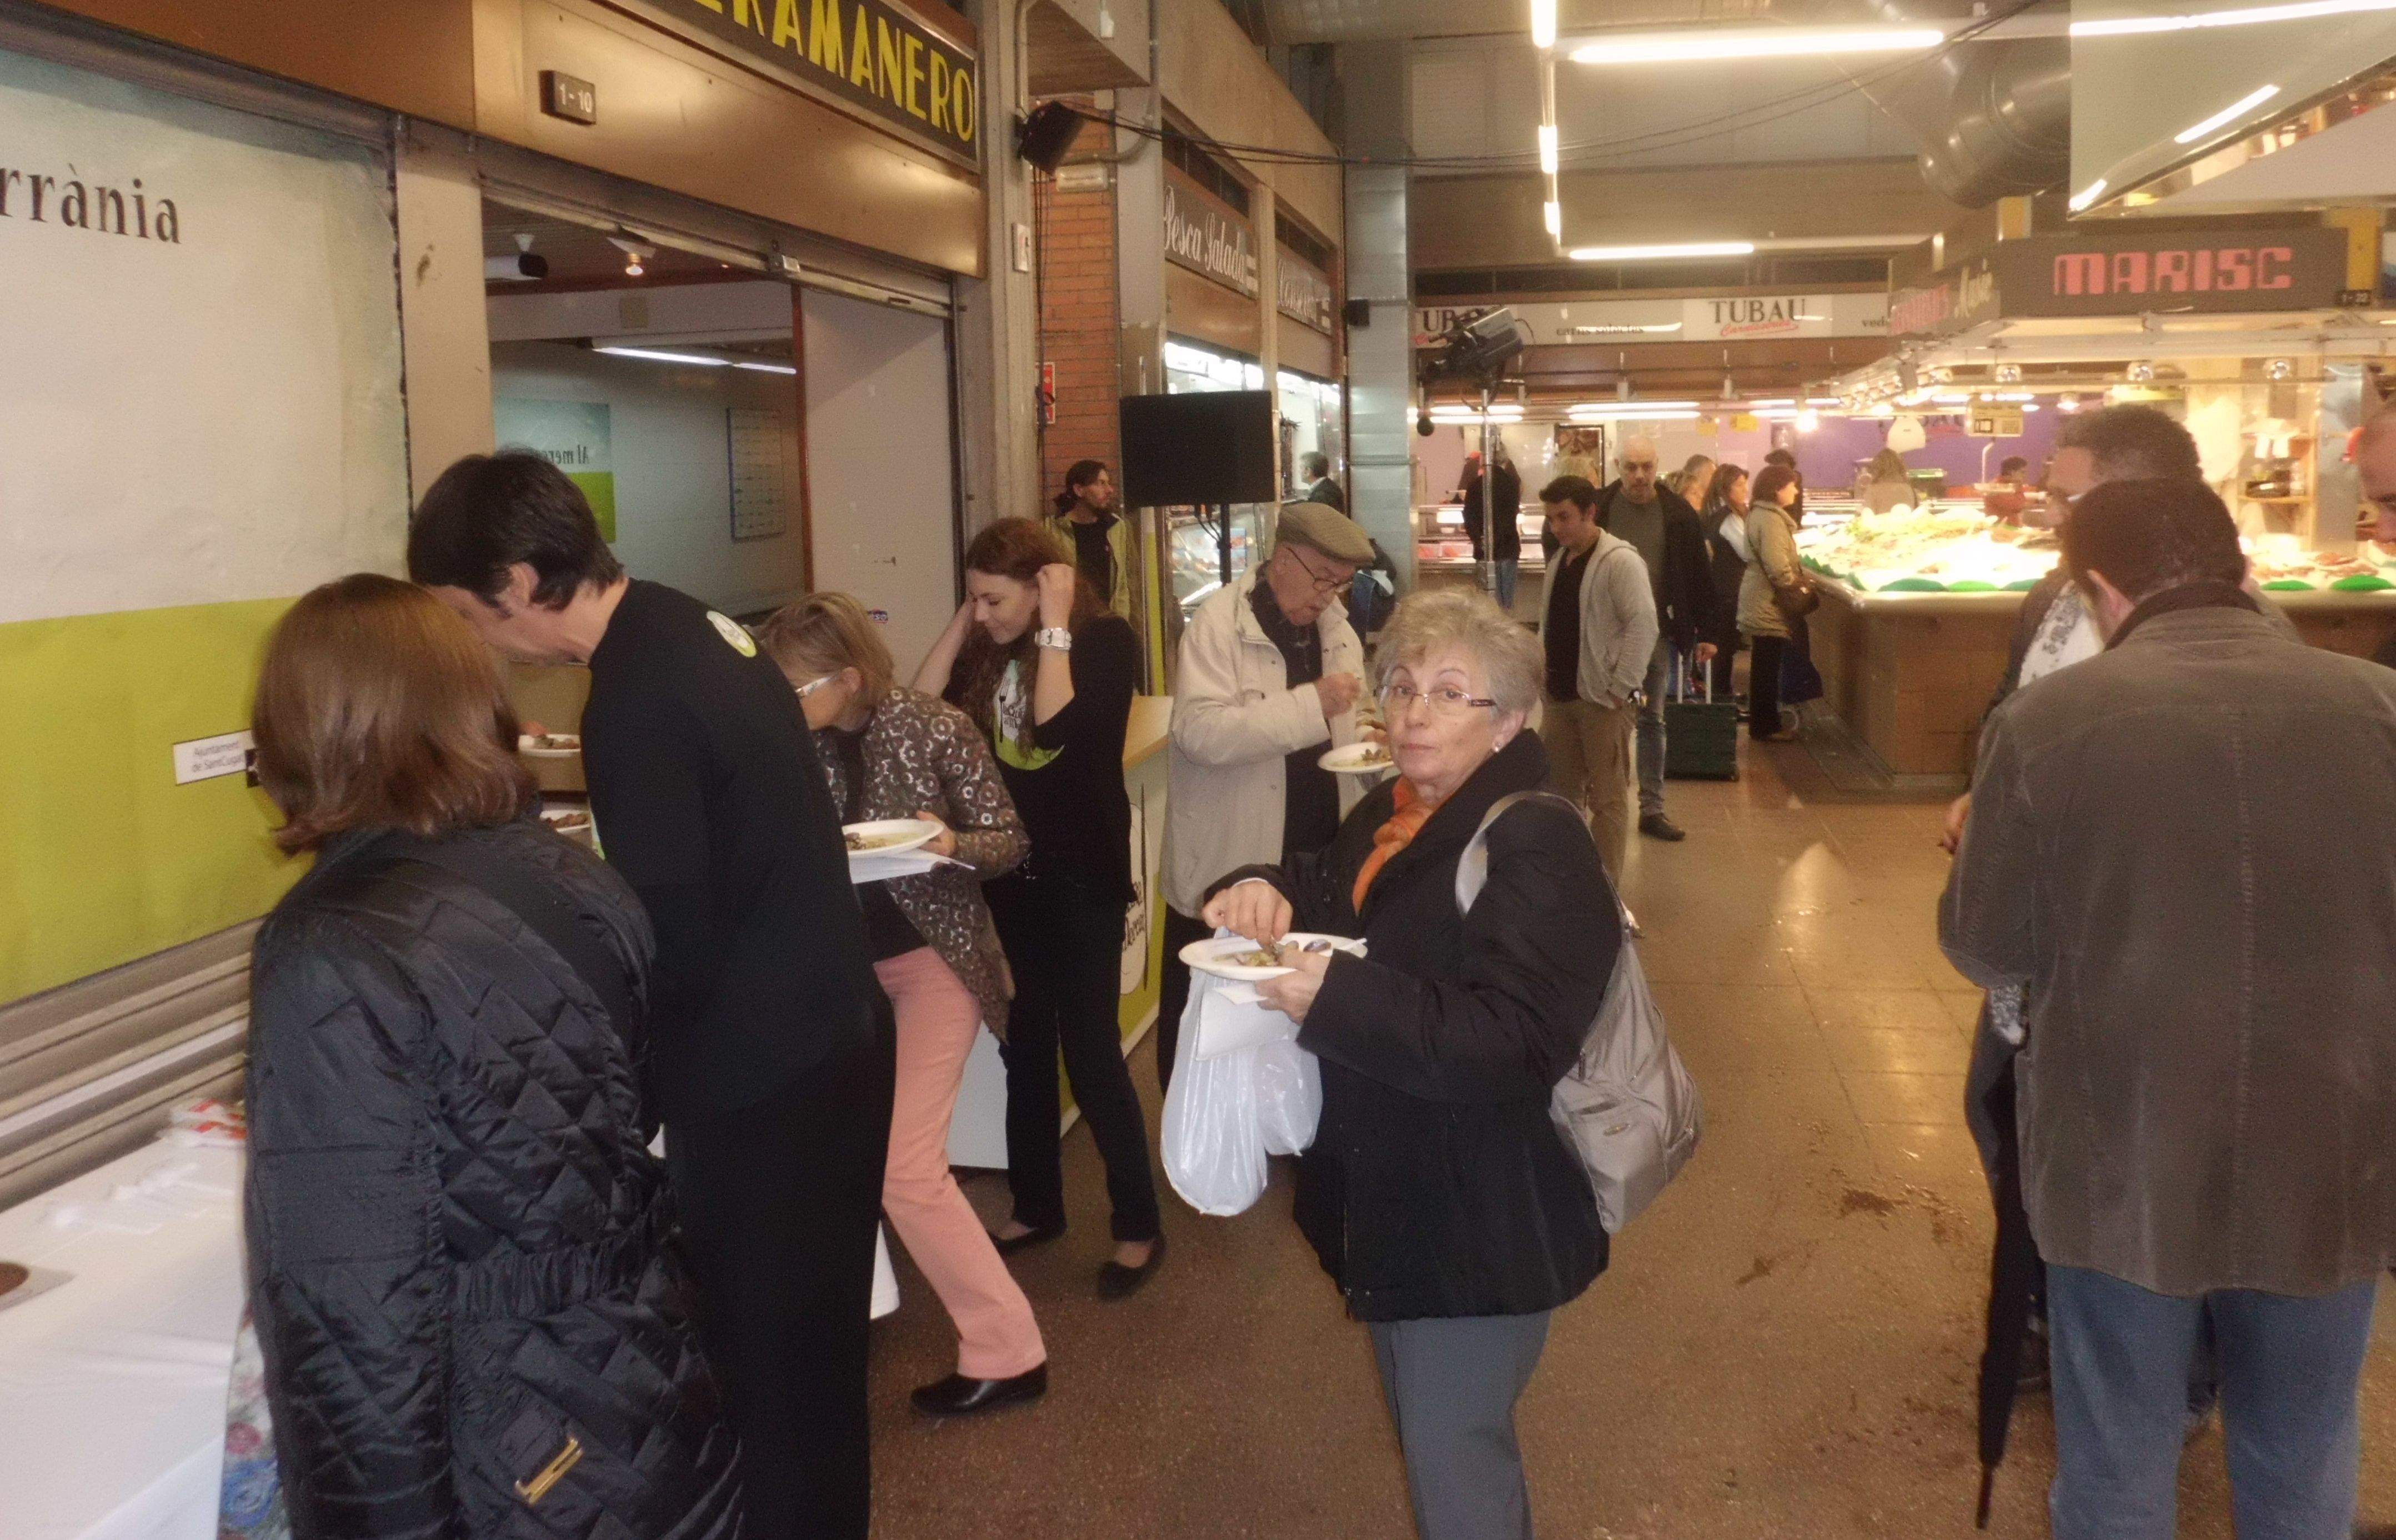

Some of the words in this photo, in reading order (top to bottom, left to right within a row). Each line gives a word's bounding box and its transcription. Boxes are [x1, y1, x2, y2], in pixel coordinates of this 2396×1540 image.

[694, 0, 974, 142] AMANERO
[2054, 246, 2293, 295] MARISC
[1707, 298, 1806, 324] TUBAU
